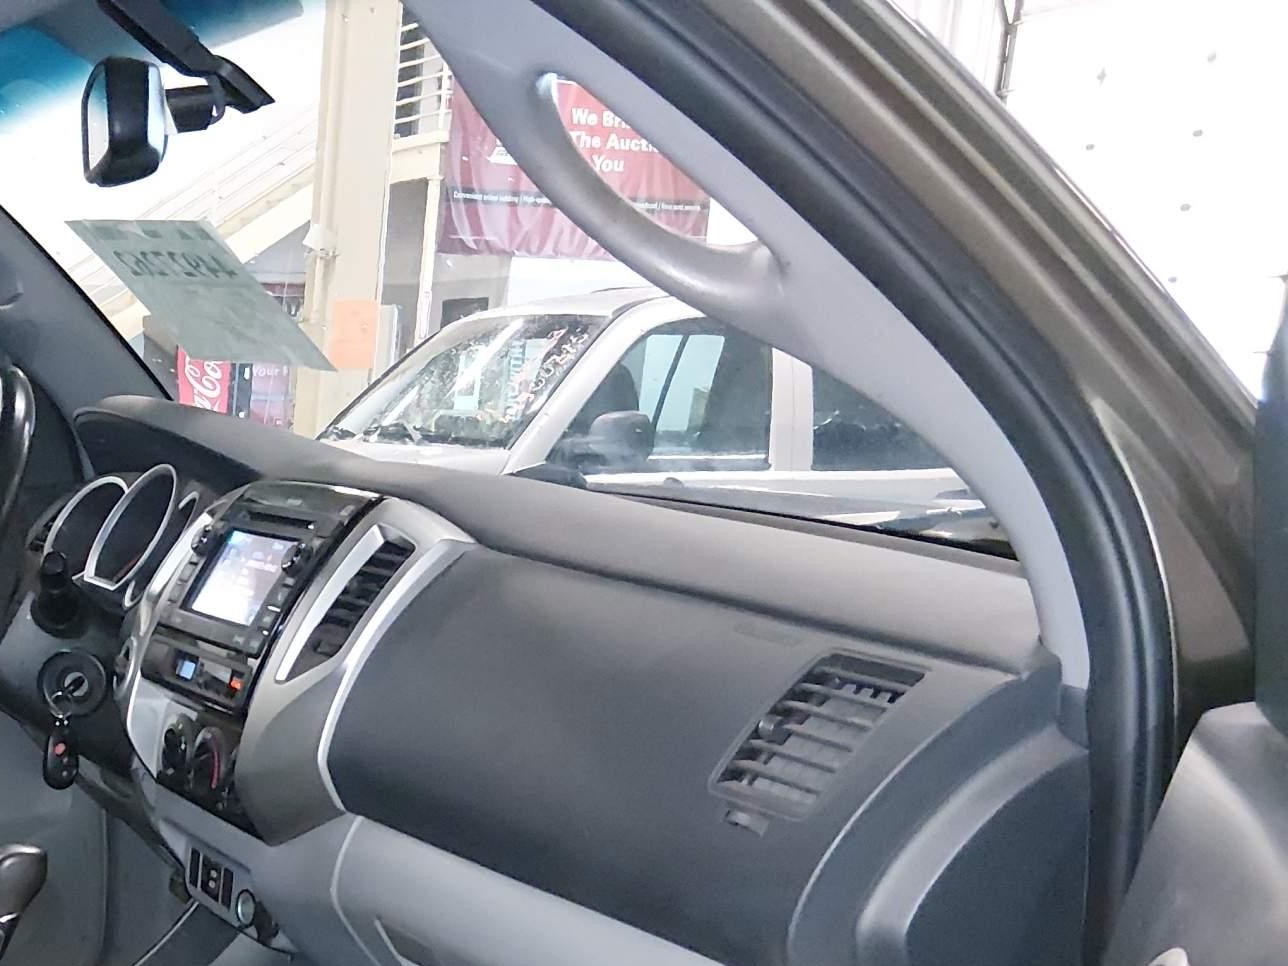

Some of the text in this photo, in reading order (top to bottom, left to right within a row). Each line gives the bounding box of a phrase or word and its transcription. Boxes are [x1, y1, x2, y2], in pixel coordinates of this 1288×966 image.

[571, 107, 631, 129] We Bri
[569, 131, 659, 153] The Aucti
[592, 154, 624, 172] You
